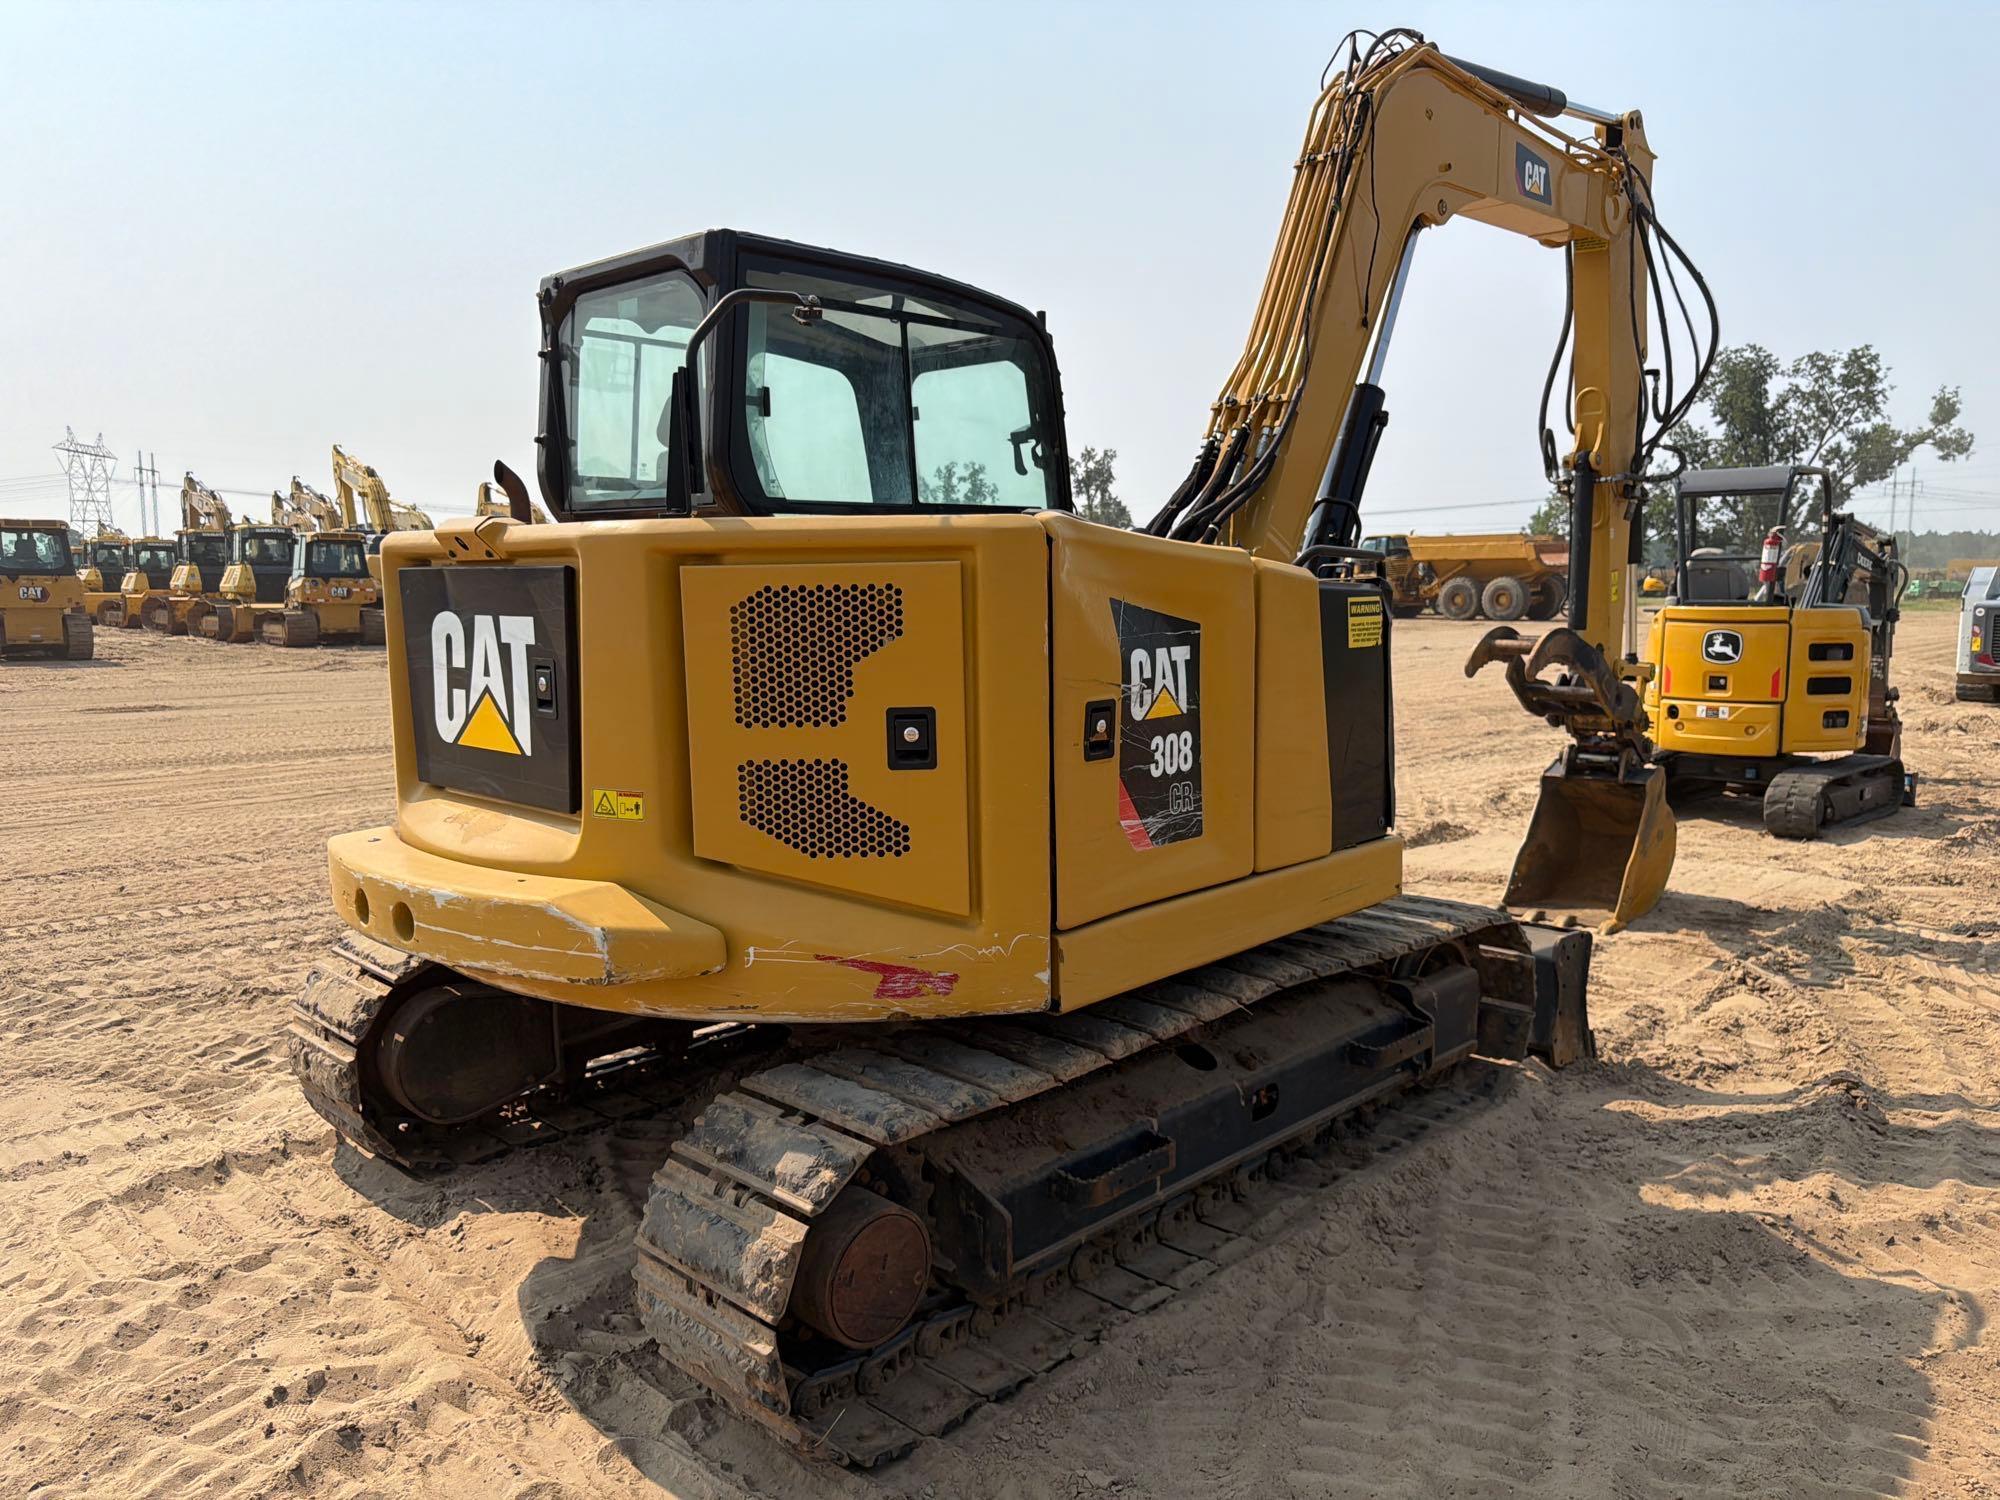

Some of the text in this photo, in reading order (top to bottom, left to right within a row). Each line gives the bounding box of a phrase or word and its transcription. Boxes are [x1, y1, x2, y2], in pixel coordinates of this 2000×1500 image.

[1525, 160, 1546, 196] CAT
[20, 586, 42, 599] CAT
[331, 586, 347, 598] CAT
[1350, 604, 1380, 614] WARNING
[431, 610, 536, 757] CAT
[1130, 645, 1191, 721] CAT
[1150, 730, 1193, 778] 308
[1169, 781, 1194, 815] CR
